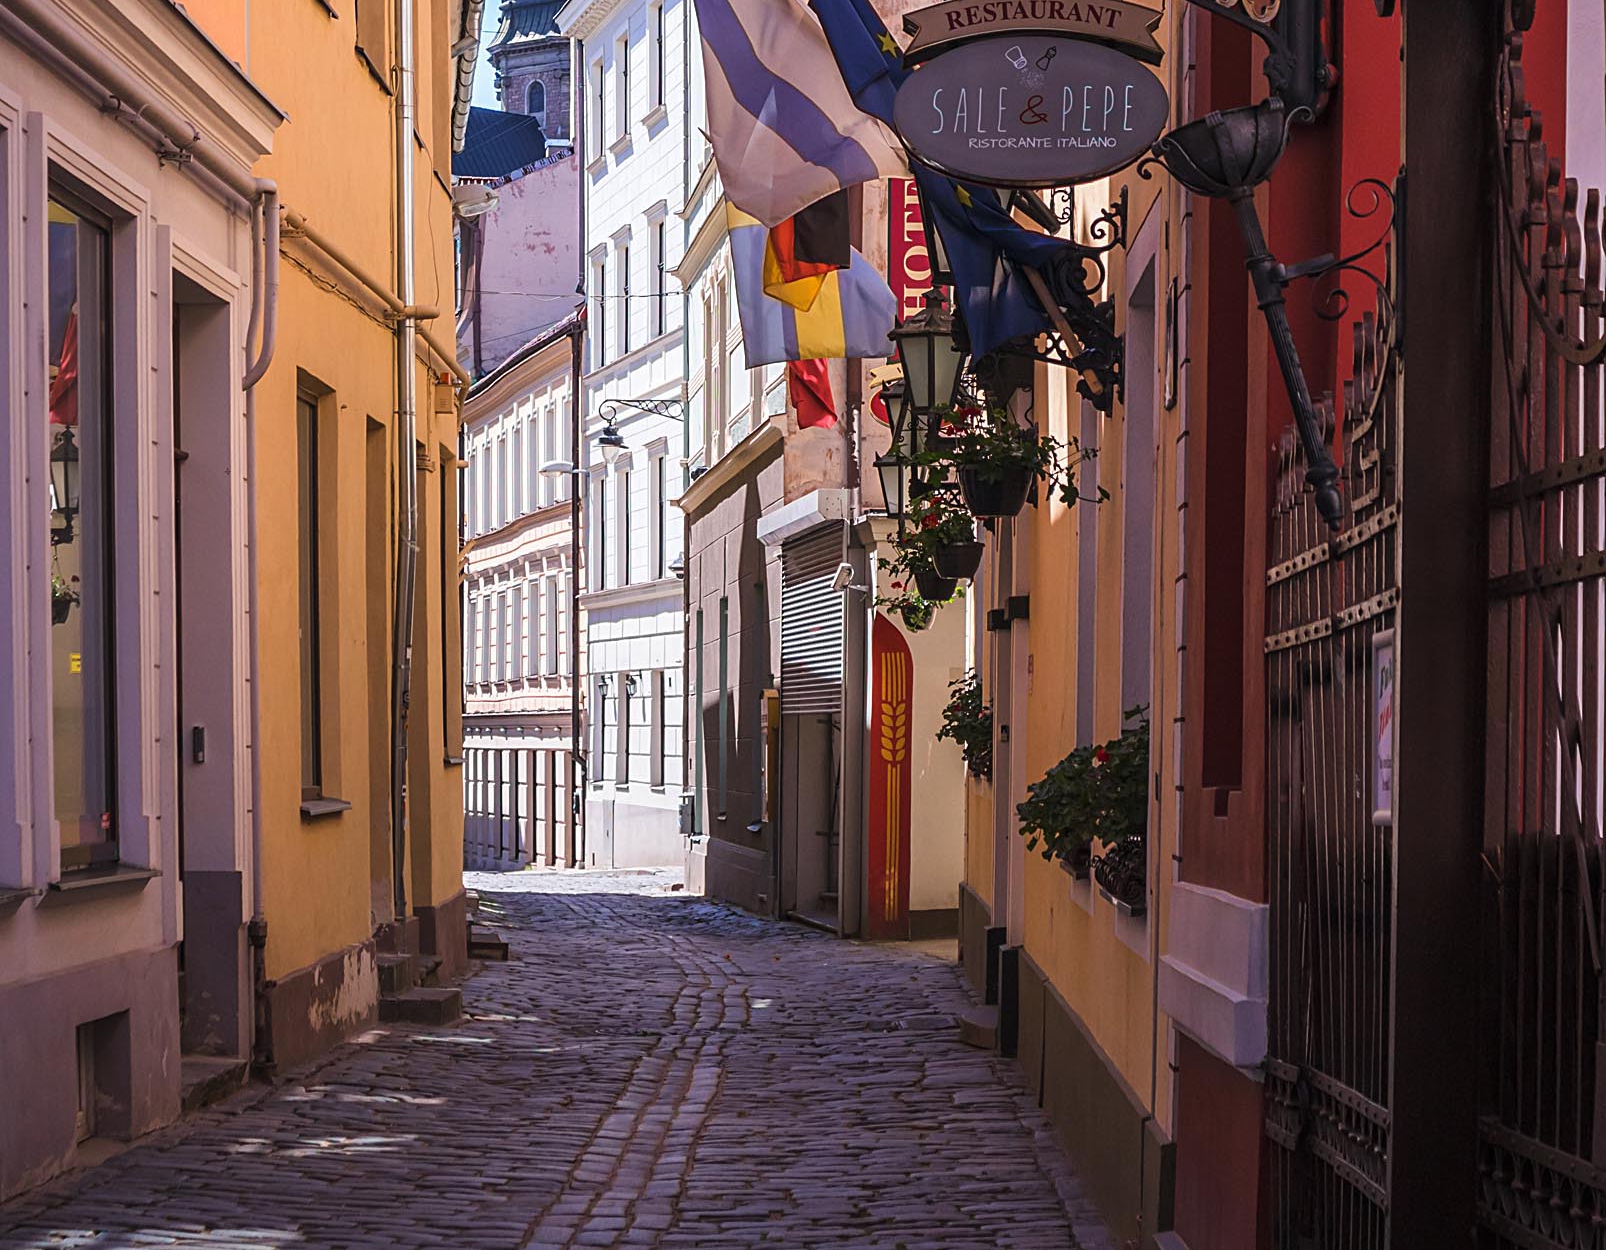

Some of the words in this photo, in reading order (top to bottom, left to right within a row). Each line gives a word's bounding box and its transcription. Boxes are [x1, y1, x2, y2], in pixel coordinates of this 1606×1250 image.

[945, 0, 1122, 30] RESTAURANT
[932, 87, 1007, 134] SALE
[1019, 95, 1048, 125] &
[1062, 85, 1134, 132] PEPE
[968, 137, 1052, 148] RISTORANTE
[1057, 137, 1117, 148] ITALIANO
